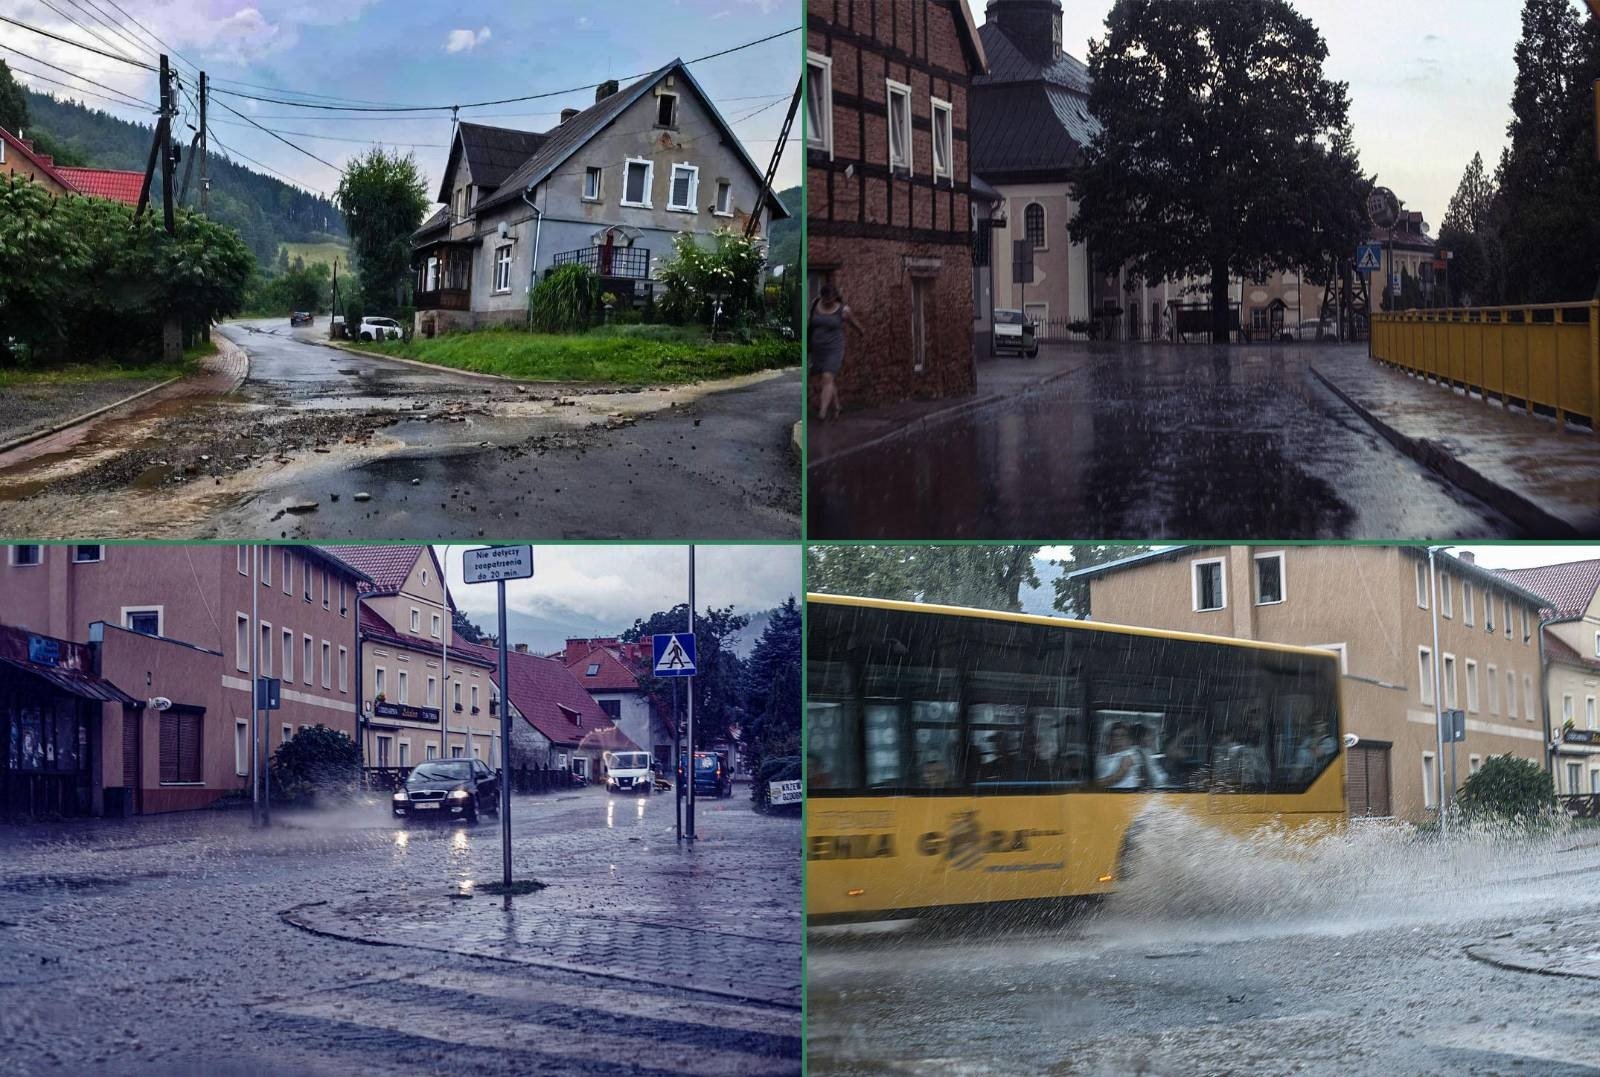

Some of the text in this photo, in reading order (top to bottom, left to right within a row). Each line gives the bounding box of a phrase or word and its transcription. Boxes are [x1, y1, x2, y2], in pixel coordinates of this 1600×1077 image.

[492, 549, 519, 558] dotyczy
[475, 558, 522, 570] zaopatrzenia
[491, 570, 500, 579] 20
